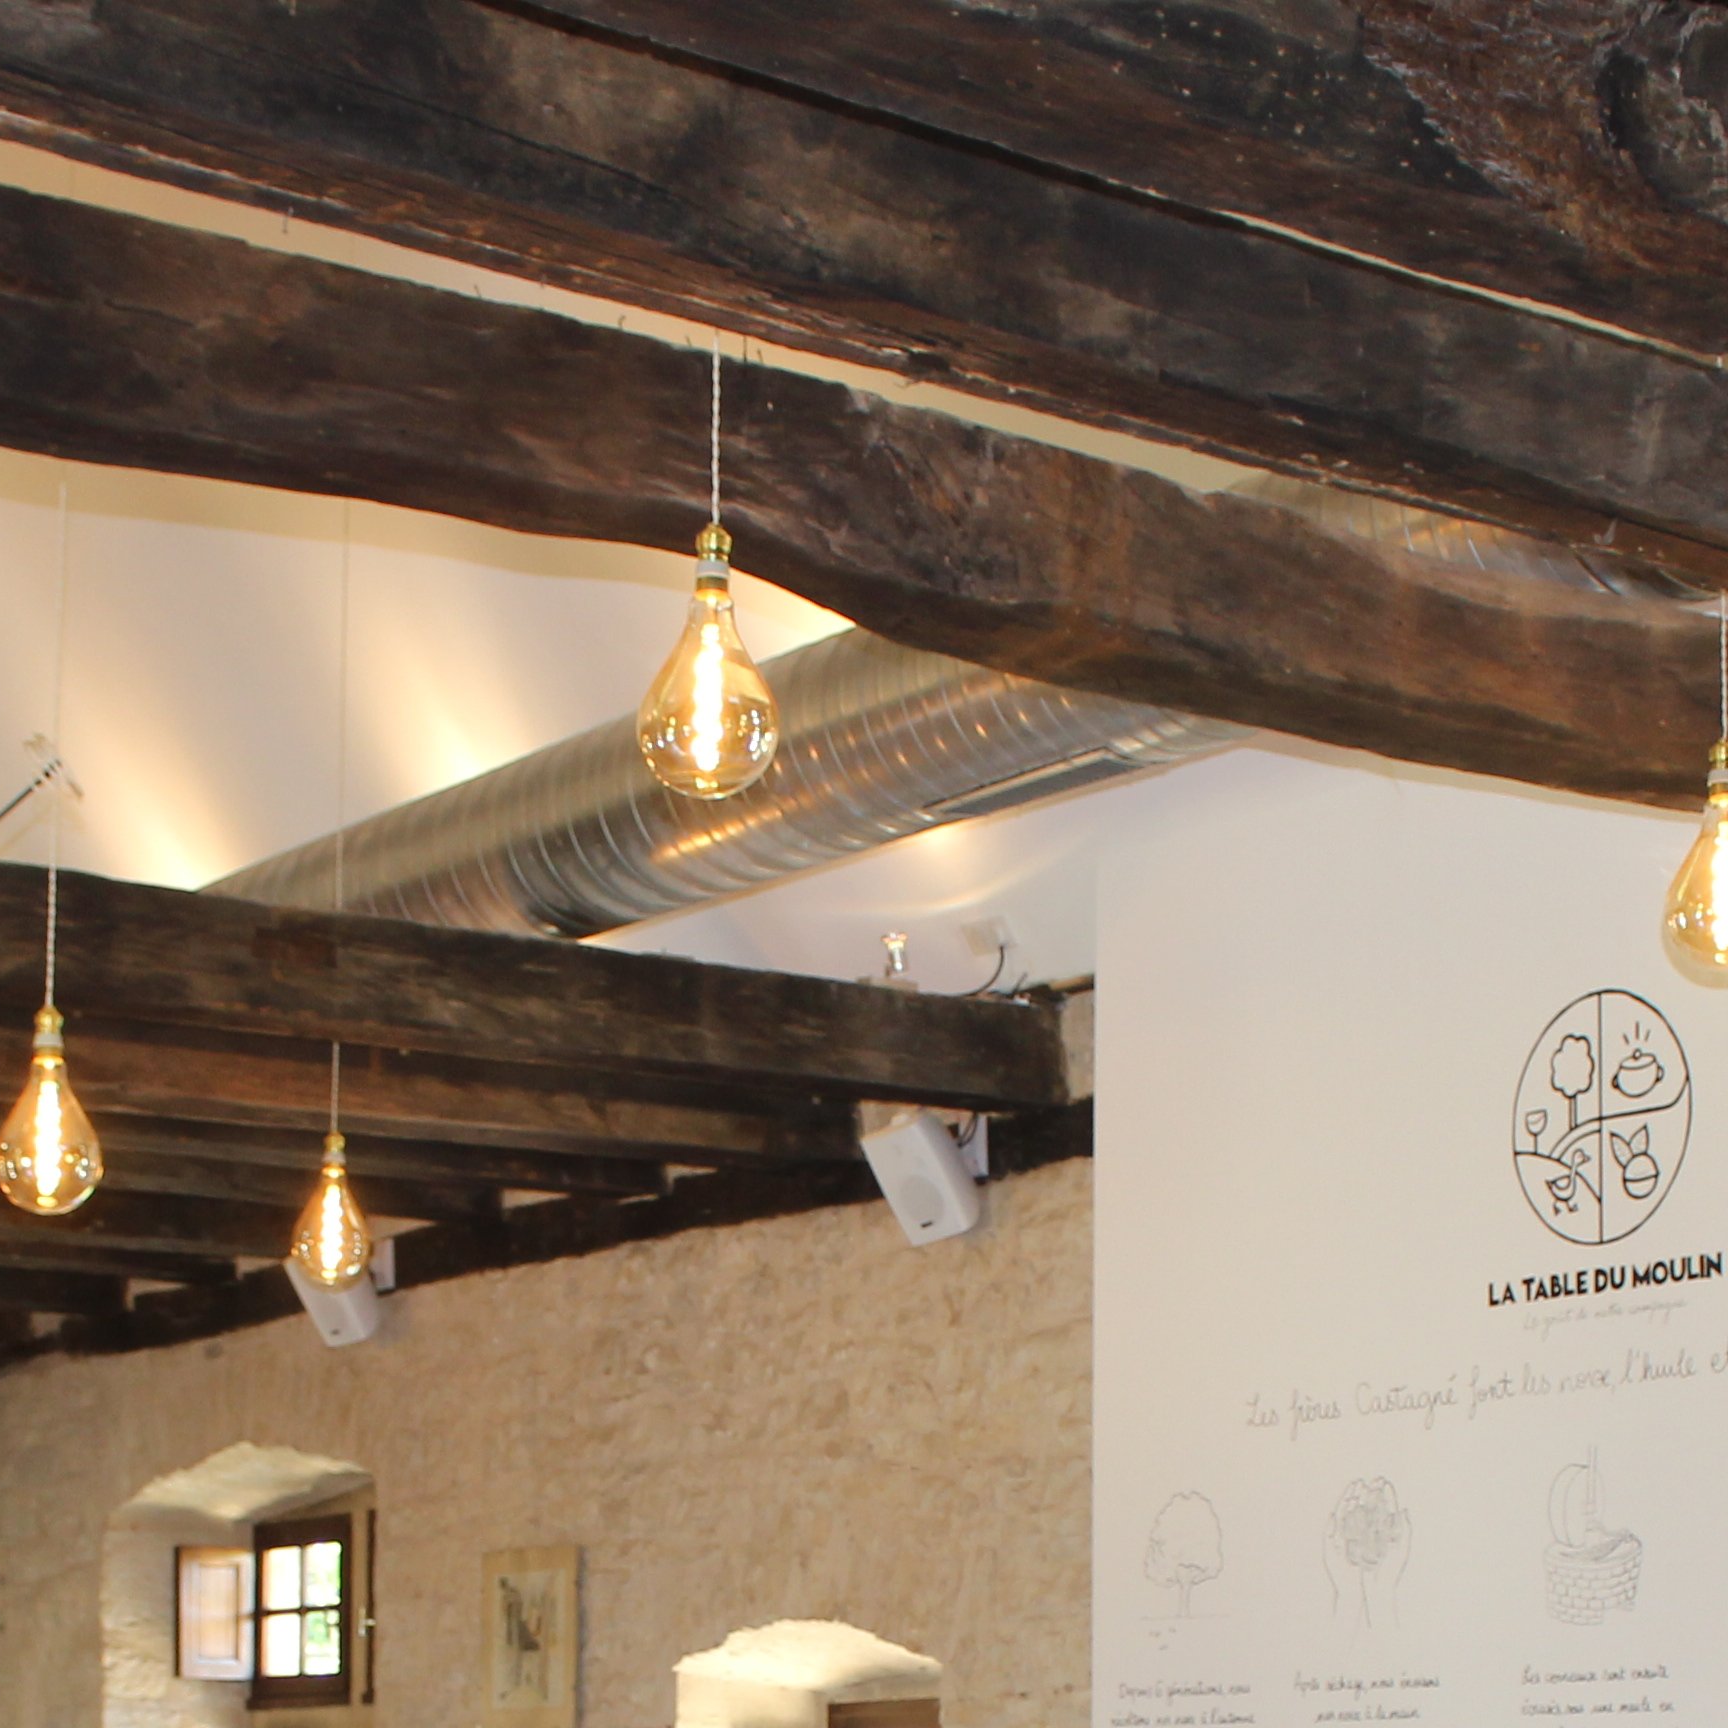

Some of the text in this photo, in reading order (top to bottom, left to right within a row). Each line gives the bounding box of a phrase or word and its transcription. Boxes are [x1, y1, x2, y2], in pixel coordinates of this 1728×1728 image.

[1488, 1251, 1723, 1307] LA TABLE DU MOULIN
[1246, 1392, 1279, 1427] Les
[1287, 1388, 1341, 1442] frères
[1355, 1373, 1458, 1431] Castagné
[1468, 1364, 1515, 1420] font
[1521, 1362, 1551, 1396] les
[1620, 1348, 1698, 1384] l'huile
[1660, 1701, 1674, 1712] en
